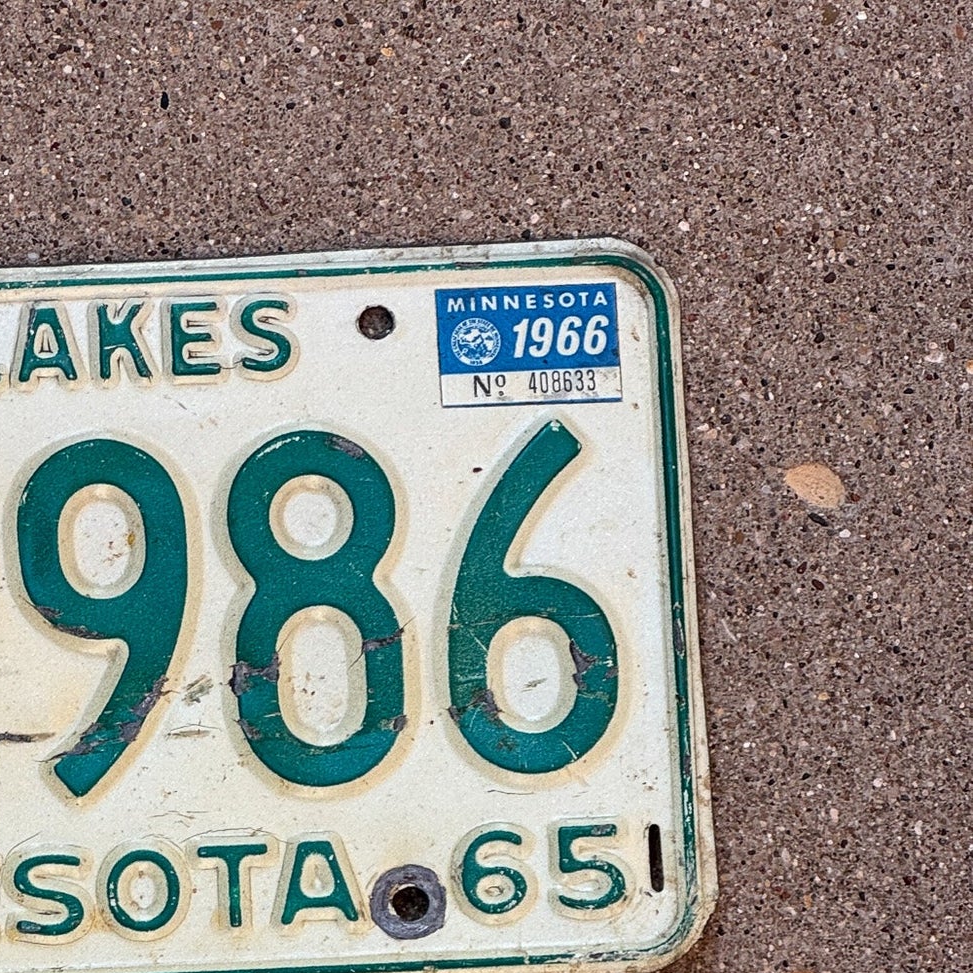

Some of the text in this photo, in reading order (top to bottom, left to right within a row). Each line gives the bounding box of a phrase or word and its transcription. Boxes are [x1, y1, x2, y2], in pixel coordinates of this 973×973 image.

[446, 291, 609, 313] MINNESOTA
[512, 314, 610, 359] 1966
[528, 369, 597, 394] 408633
[16, 419, 620, 799] 986
[460, 823, 627, 915] 65
